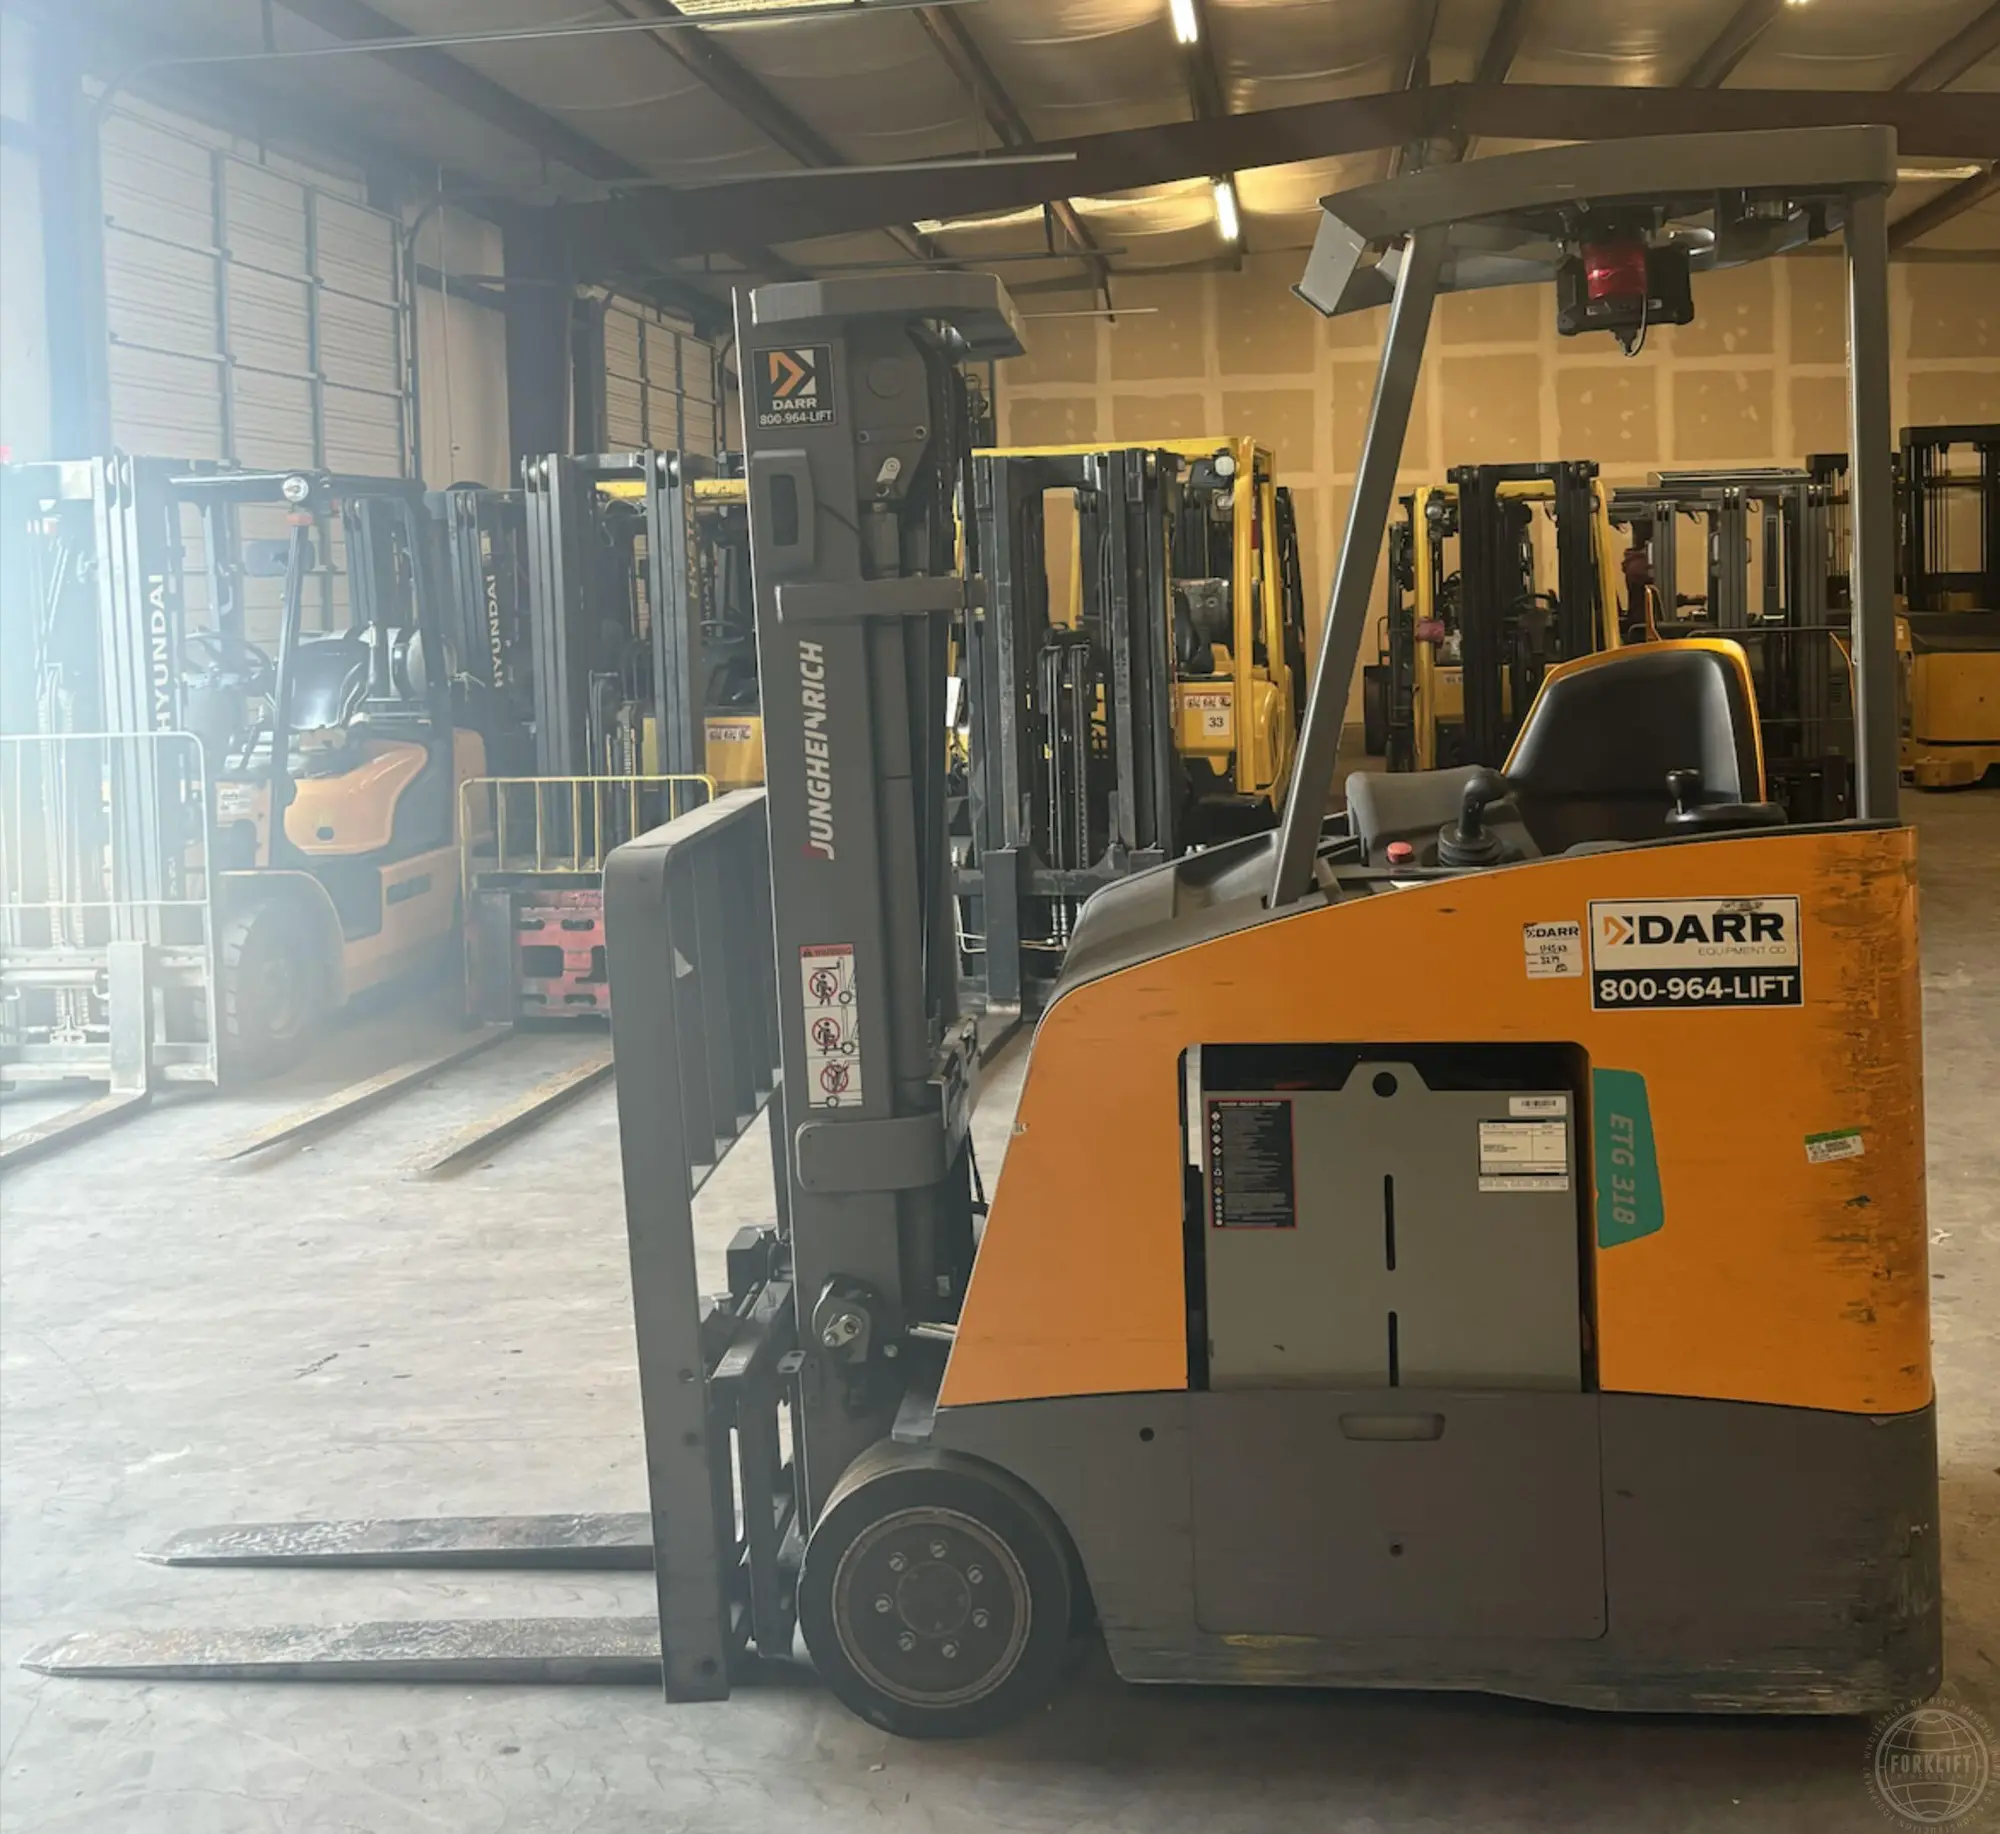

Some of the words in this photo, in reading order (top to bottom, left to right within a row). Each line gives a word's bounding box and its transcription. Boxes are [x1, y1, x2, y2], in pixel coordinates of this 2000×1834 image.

[760, 410, 832, 425] 800-964-LIFT
[773, 398, 817, 410] DARR
[486, 575, 503, 687] HYUNDAI
[148, 575, 171, 732] HYUNDAI
[1208, 716, 1224, 728] 33
[799, 640, 835, 860] JUNGHEINRICH
[1536, 927, 1579, 938] DARR
[1638, 913, 1785, 945] DARR
[1698, 947, 1765, 957] EQUIPMENT
[1769, 946, 1787, 956] CO
[1600, 975, 1795, 1002] 800-964-LIFT
[1611, 1113, 1636, 1168] ETG
[1612, 1174, 1637, 1225] 318
